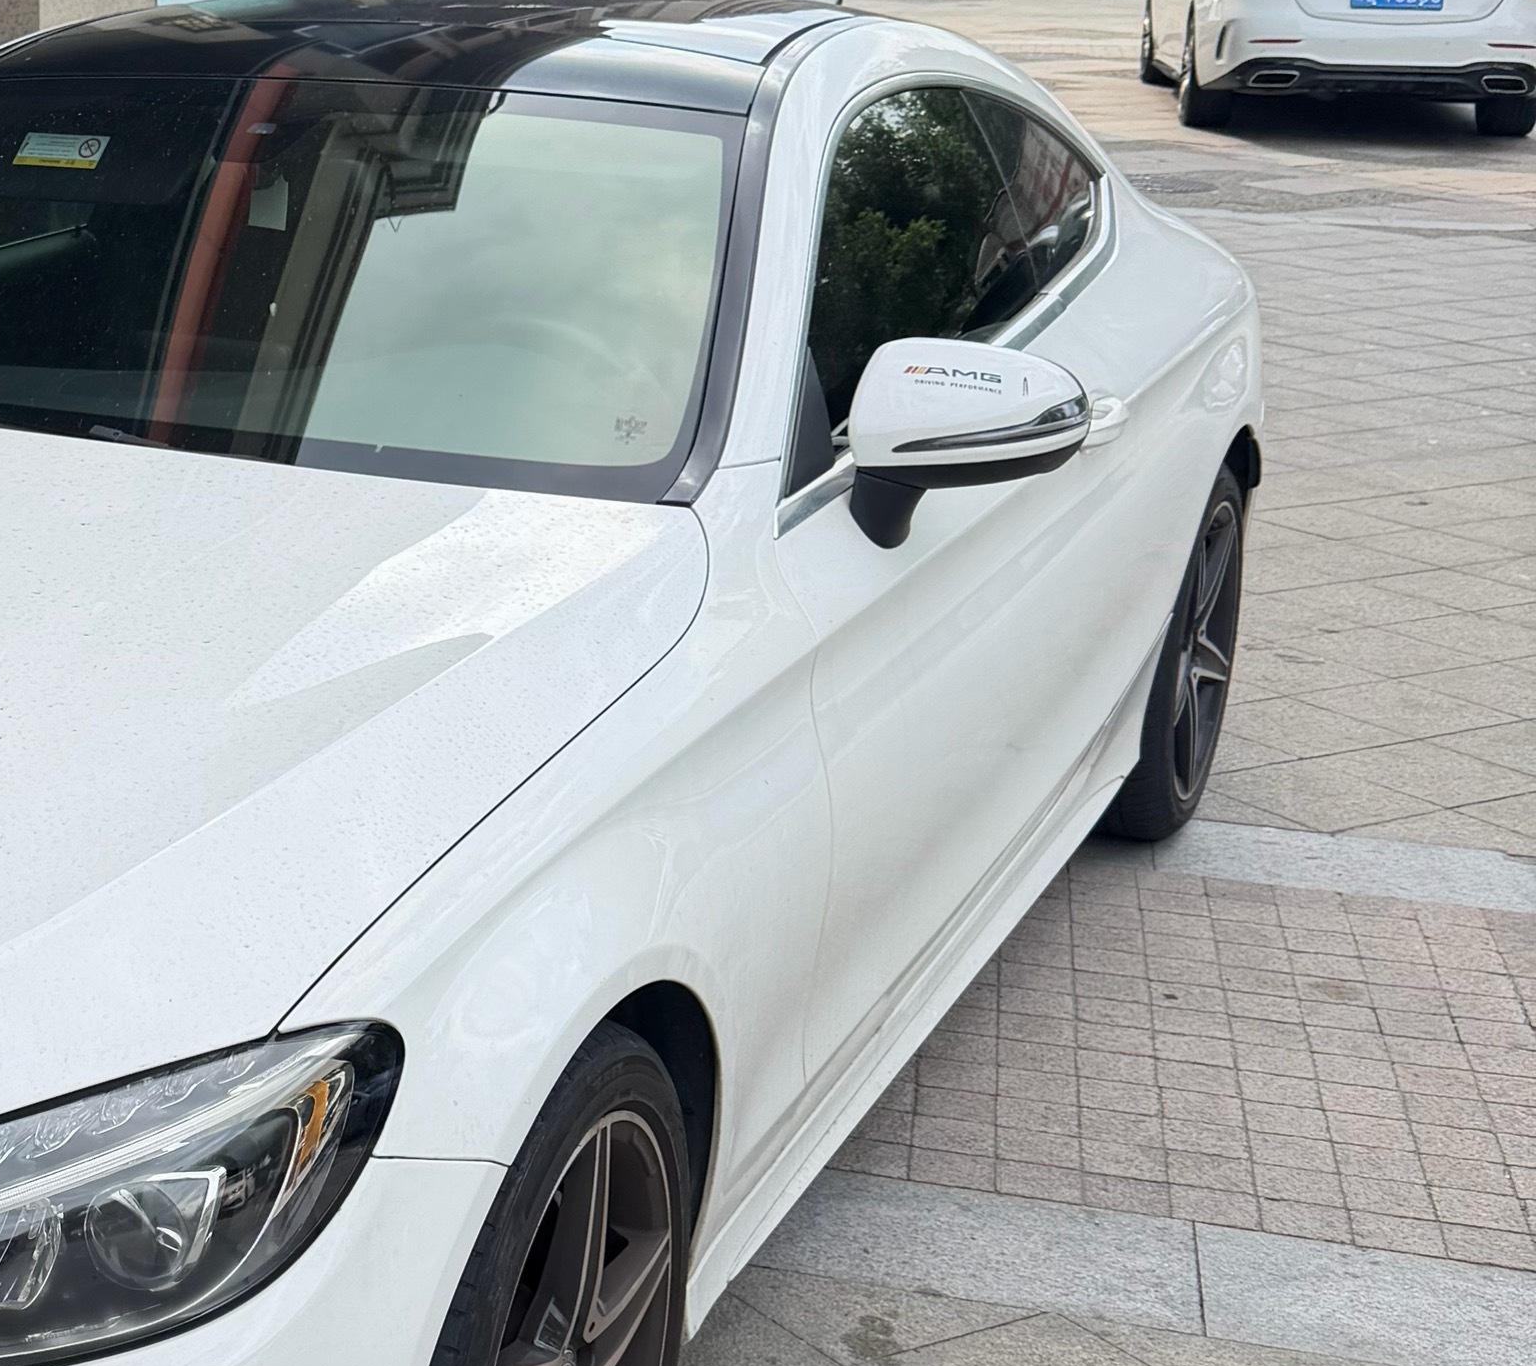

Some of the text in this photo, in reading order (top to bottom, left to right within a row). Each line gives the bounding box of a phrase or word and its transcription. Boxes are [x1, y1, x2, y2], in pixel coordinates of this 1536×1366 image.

[924, 366, 1002, 384] AMG
[914, 378, 1002, 395] DRIVING PERFORMANCE
